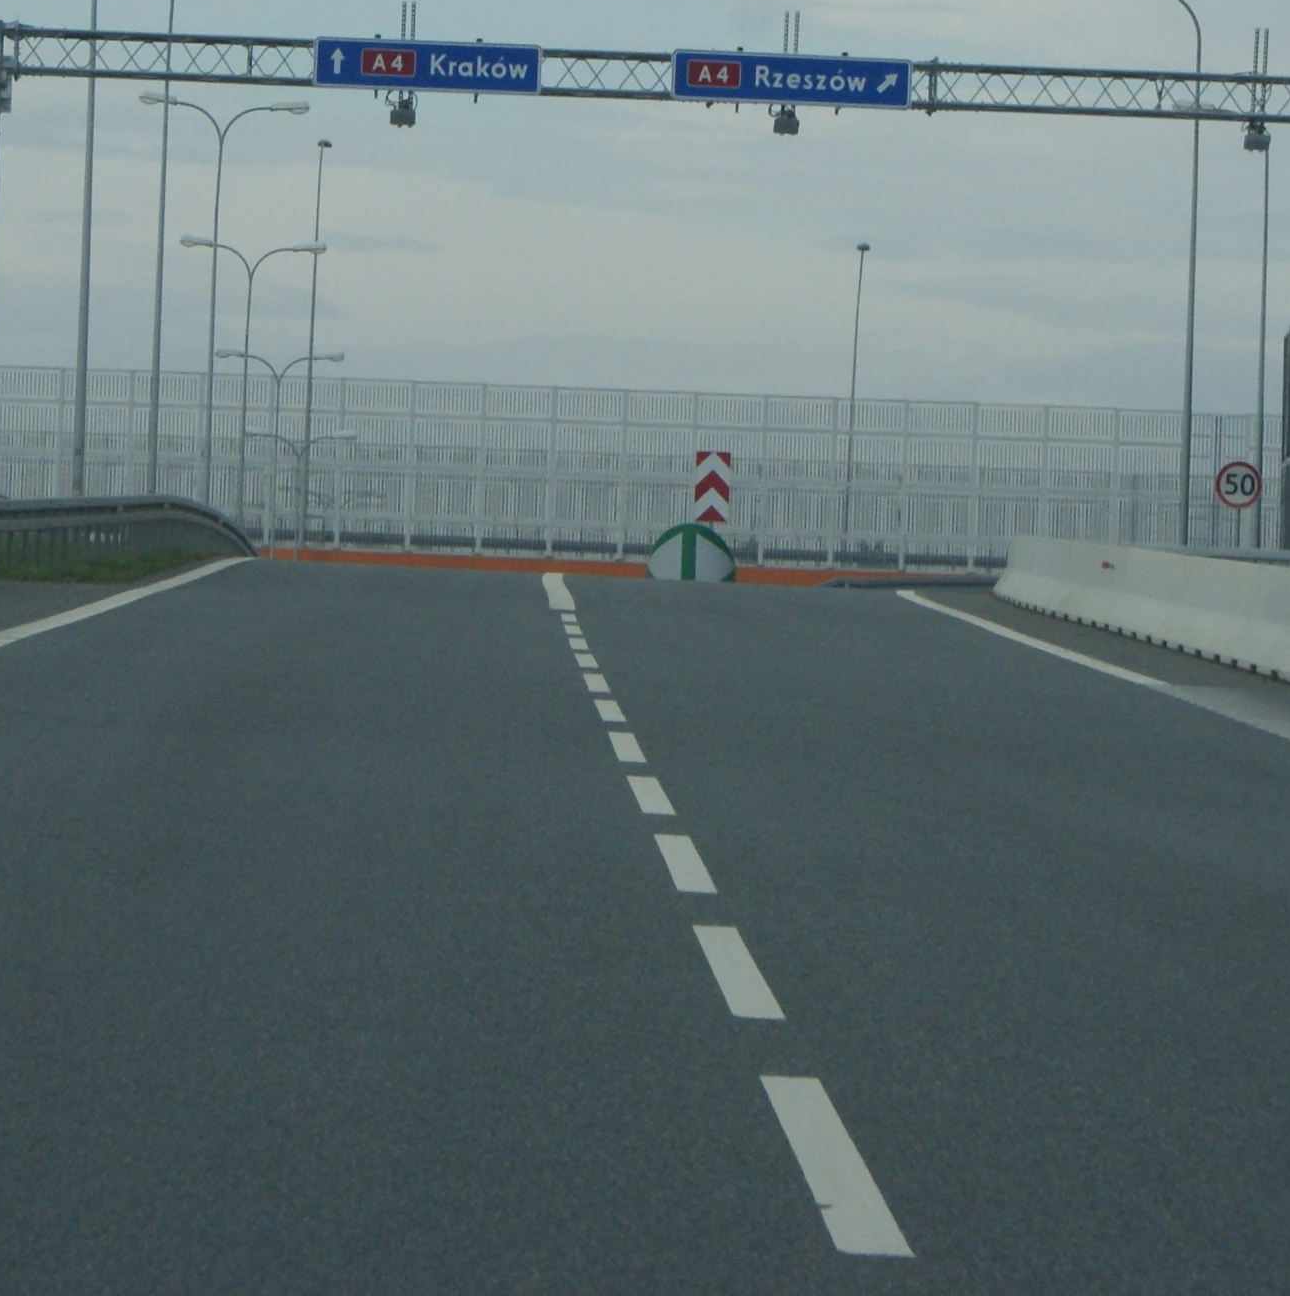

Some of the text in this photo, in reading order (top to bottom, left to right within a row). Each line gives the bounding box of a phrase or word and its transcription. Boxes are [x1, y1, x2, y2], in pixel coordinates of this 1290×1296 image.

[372, 54, 528, 80] A4 Kraków
[698, 65, 867, 93] A4 Rzeszów
[1224, 473, 1255, 496] 50
